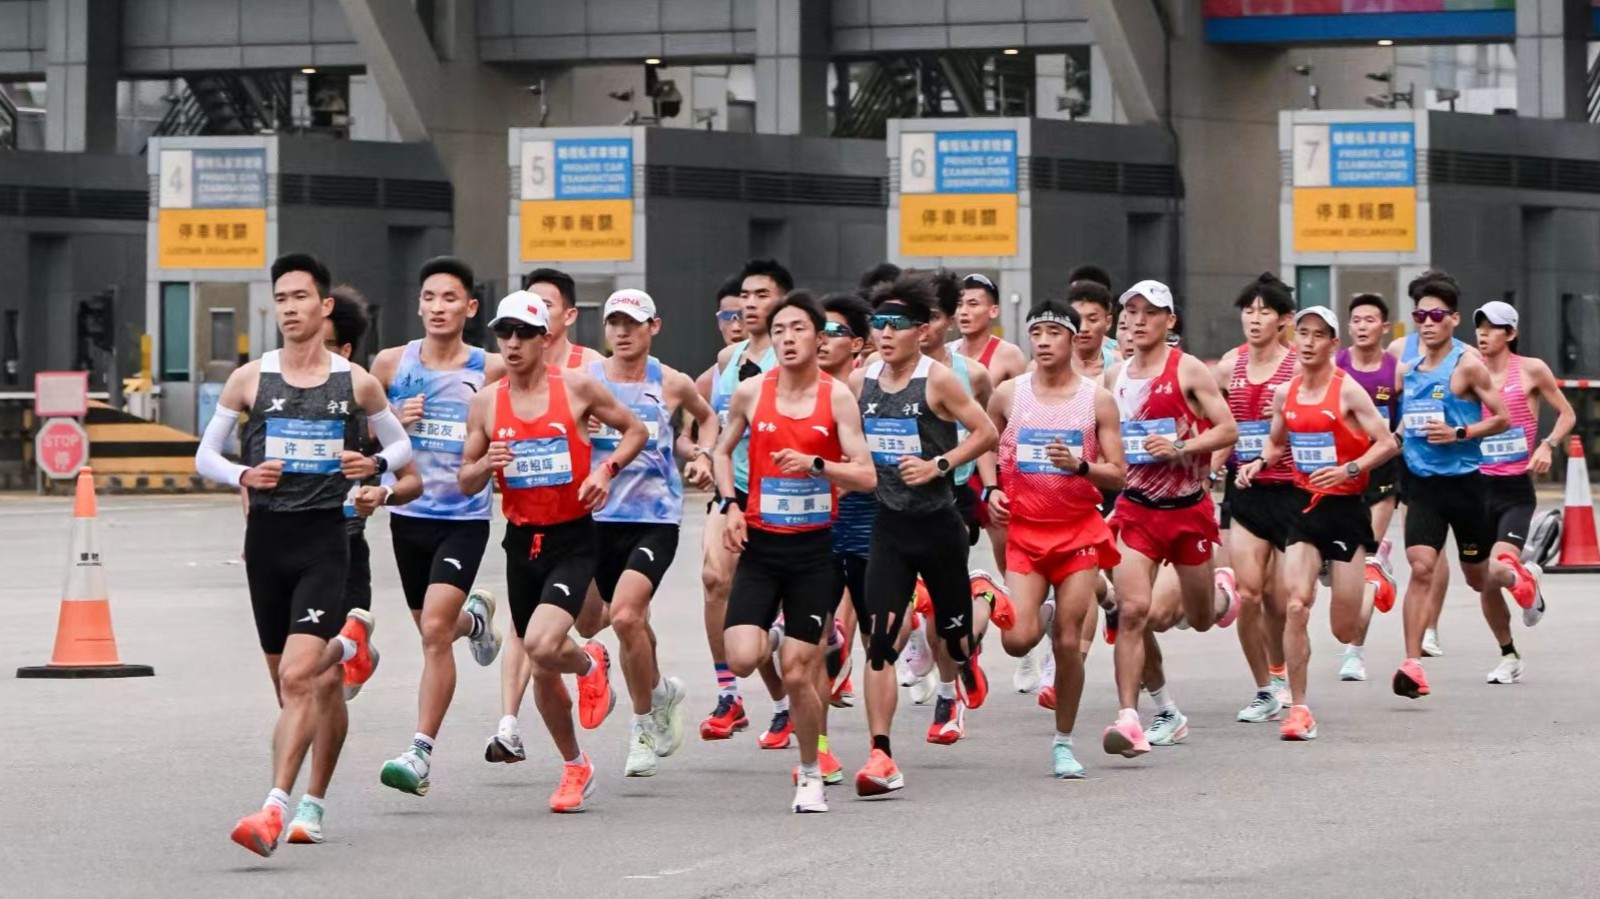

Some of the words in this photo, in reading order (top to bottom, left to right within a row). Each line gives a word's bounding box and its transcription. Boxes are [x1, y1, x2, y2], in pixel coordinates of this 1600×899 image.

[1305, 141, 1319, 171] 7
[1383, 148, 1405, 158] CAR
[603, 163, 624, 172] CAR
[911, 147, 926, 178] 6
[985, 156, 1007, 165] CAR
[169, 165, 182, 191] 4
[532, 156, 546, 186] 5
[611, 297, 640, 307] CHINA
[327, 400, 350, 414] 宁夏
[902, 402, 923, 416] 宁夏
[44, 435, 79, 449] STOP
